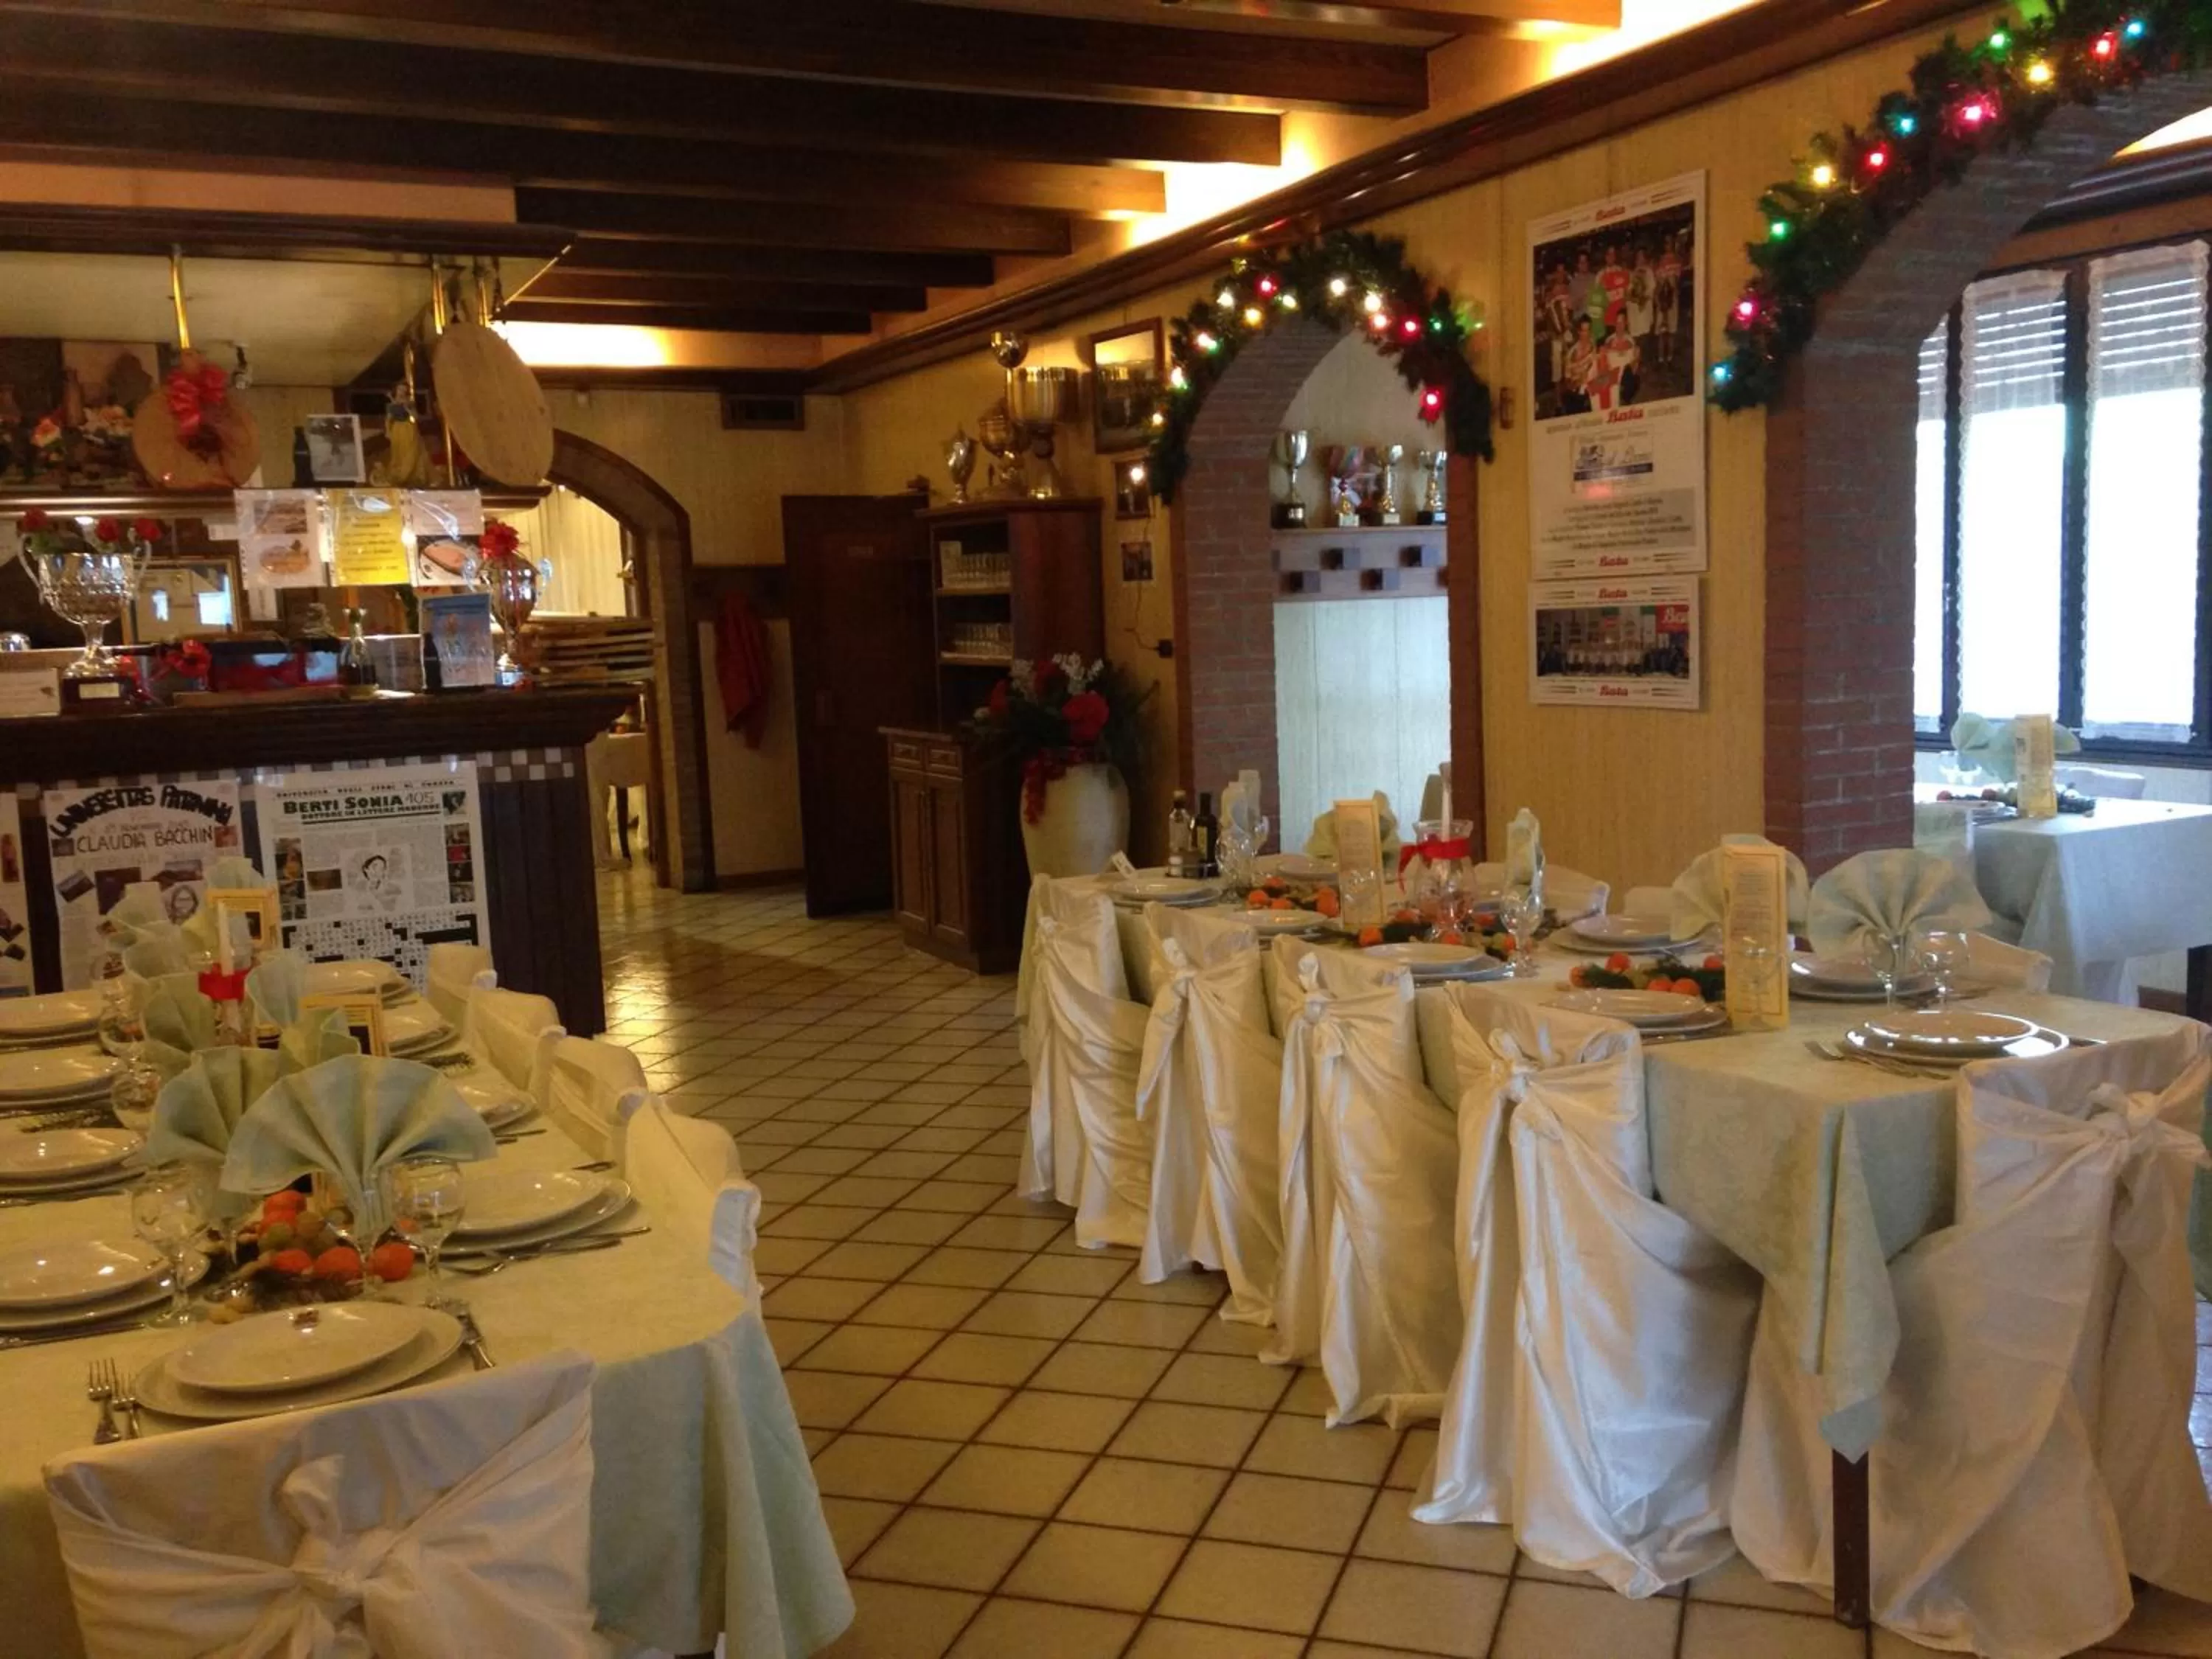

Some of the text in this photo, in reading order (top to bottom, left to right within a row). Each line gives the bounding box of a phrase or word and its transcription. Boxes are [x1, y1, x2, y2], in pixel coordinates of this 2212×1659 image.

[283, 799, 338, 814] BERTI
[344, 795, 403, 810] SONIA
[77, 832, 147, 853] CLAUDIA
